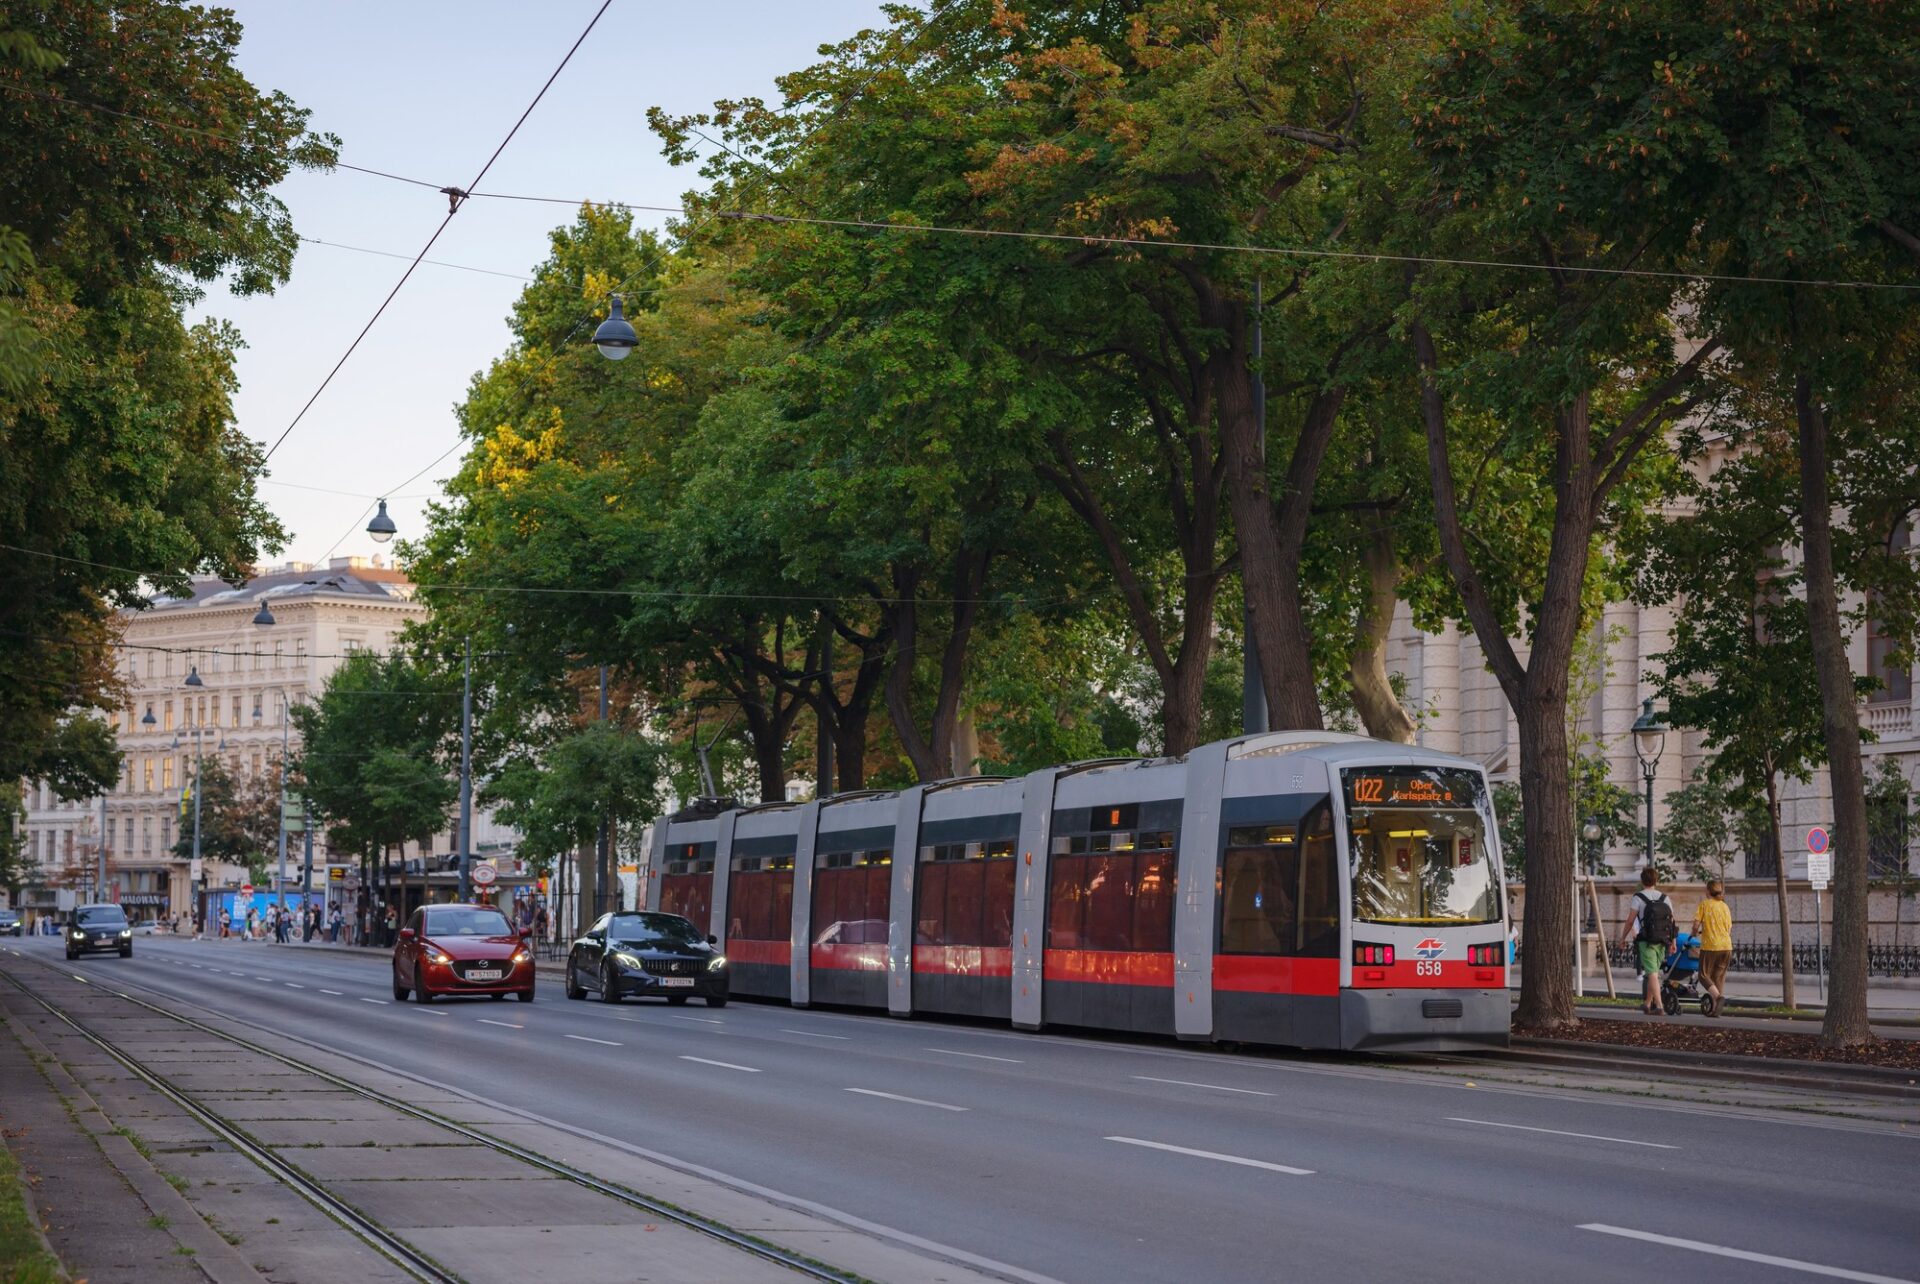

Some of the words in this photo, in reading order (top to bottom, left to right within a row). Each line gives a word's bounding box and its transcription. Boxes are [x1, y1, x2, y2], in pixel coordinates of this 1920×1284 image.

[1410, 780, 1434, 791] Oper
[1392, 790, 1442, 801] Karlsplatz
[1416, 961, 1442, 976] 658
